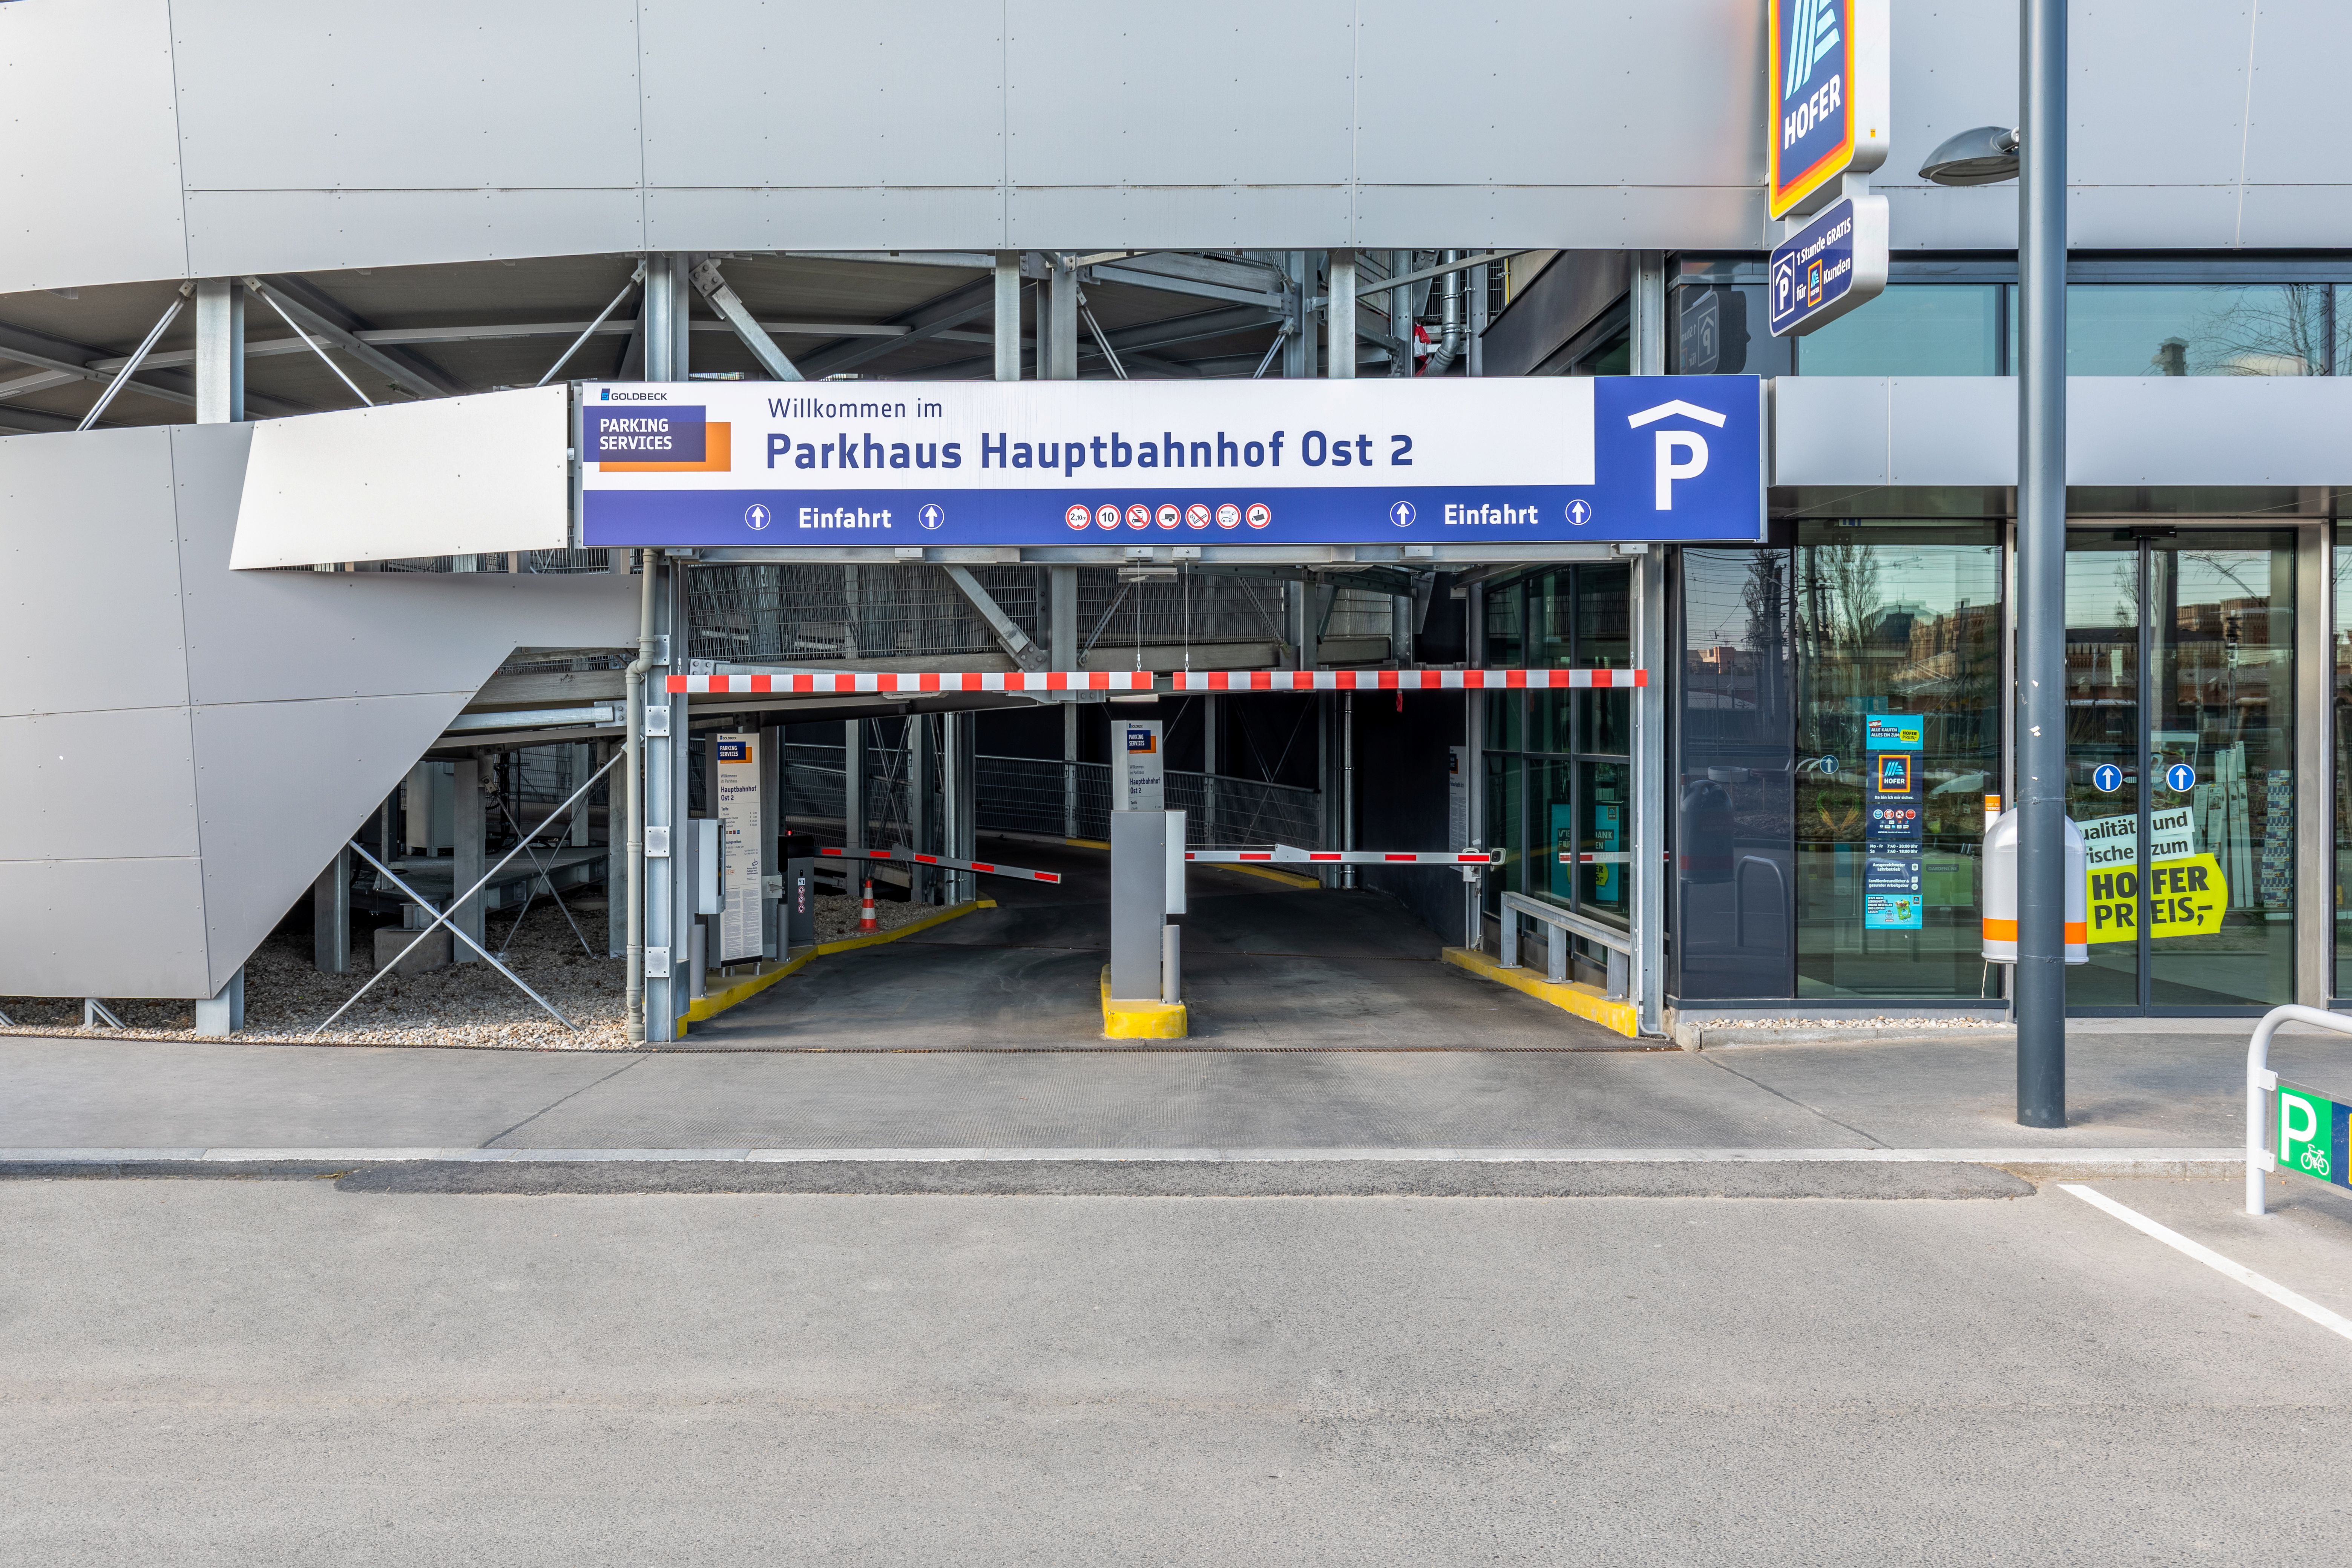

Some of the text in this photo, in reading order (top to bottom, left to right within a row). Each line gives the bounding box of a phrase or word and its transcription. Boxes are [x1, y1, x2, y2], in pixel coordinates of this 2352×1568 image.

[1784, 74, 1841, 150] HOFER
[1796, 217, 1851, 266] 1 Stunde GRATIS
[1796, 258, 1851, 301] für HOFER Kunden
[1780, 277, 1789, 311] P
[768, 398, 942, 418] Willkommen im
[600, 418, 668, 432] PARKING
[599, 435, 672, 450] SERVICES
[767, 430, 1413, 477] Parkhaus Hauptbahnhof Ost 2
[1655, 430, 1708, 510] P
[799, 507, 892, 529] Einfahrt
[1101, 512, 1114, 522] 10
[1445, 503, 1538, 525] Einfahrt
[721, 785, 757, 794] Hauptbahnhof
[1130, 777, 1160, 786] Hauptbahnhof
[2080, 811, 2188, 840] ualität und
[2087, 840, 2188, 863] ische zum
[2281, 1092, 2317, 1162] P
